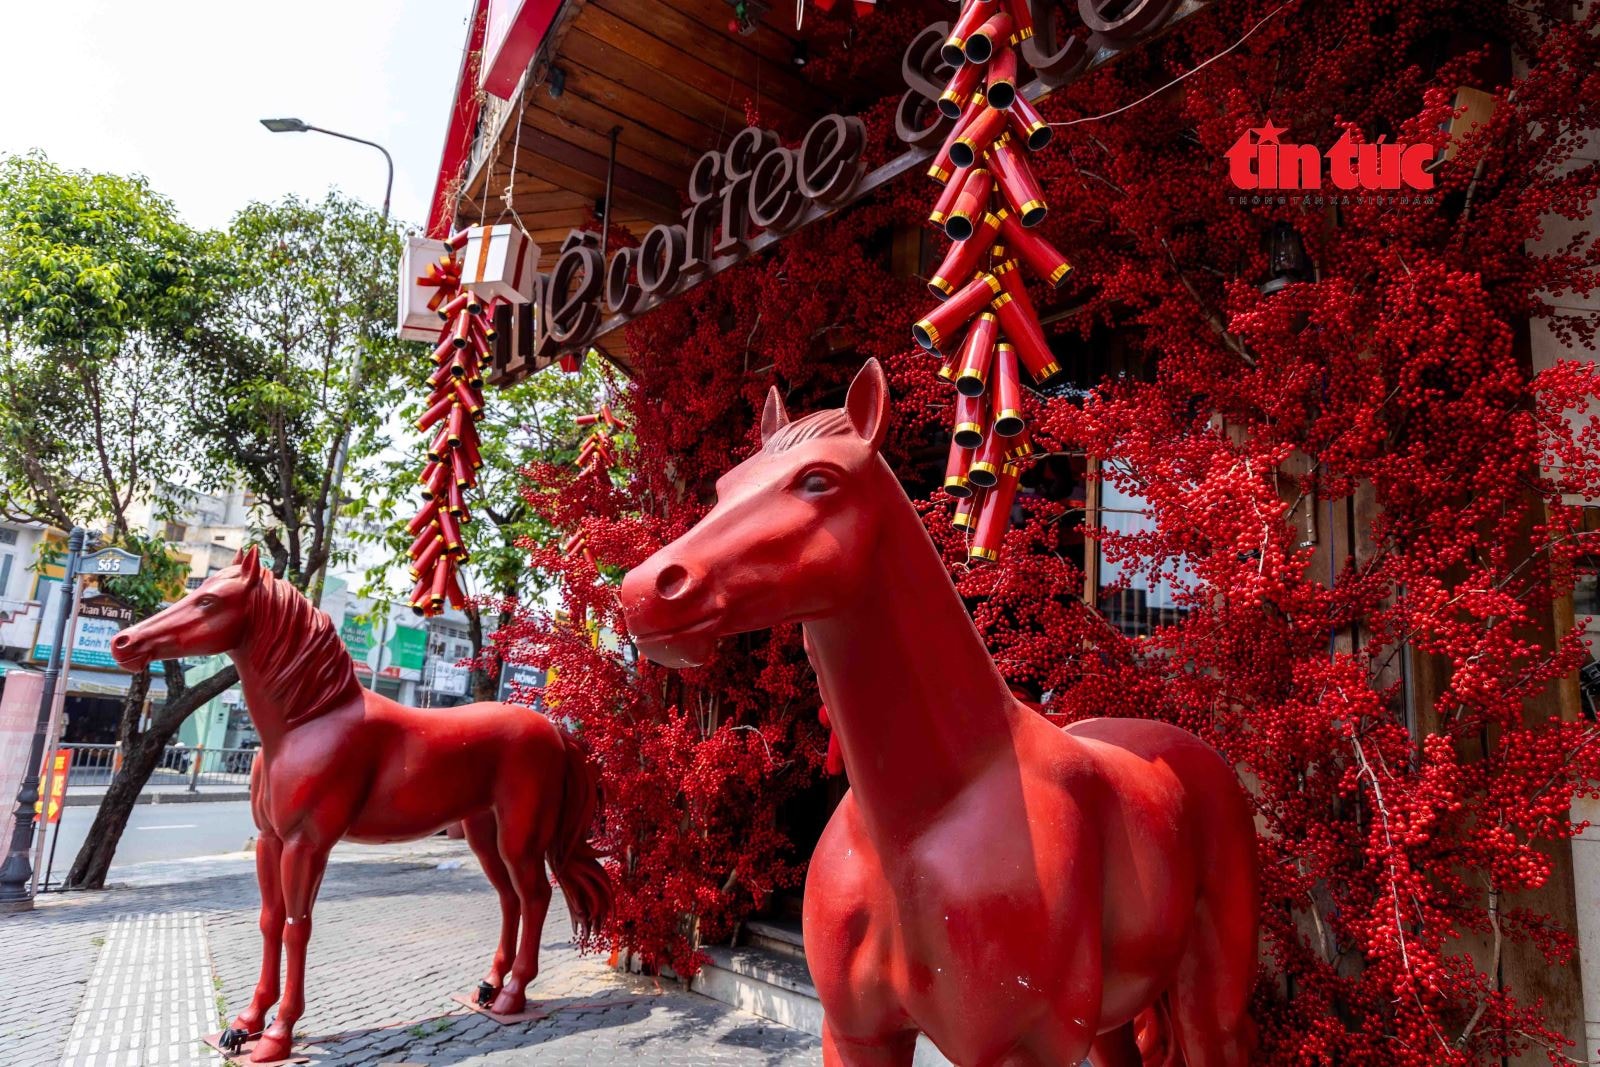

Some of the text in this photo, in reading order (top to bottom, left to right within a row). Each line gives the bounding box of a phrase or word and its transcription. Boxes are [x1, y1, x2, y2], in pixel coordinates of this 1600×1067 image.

[607, 113, 856, 313] coffee
[97, 557, 120, 571] Số 5
[79, 603, 132, 621] Phan Văn Trị
[82, 623, 105, 635] Bánh
[79, 636, 102, 648] Bánh
